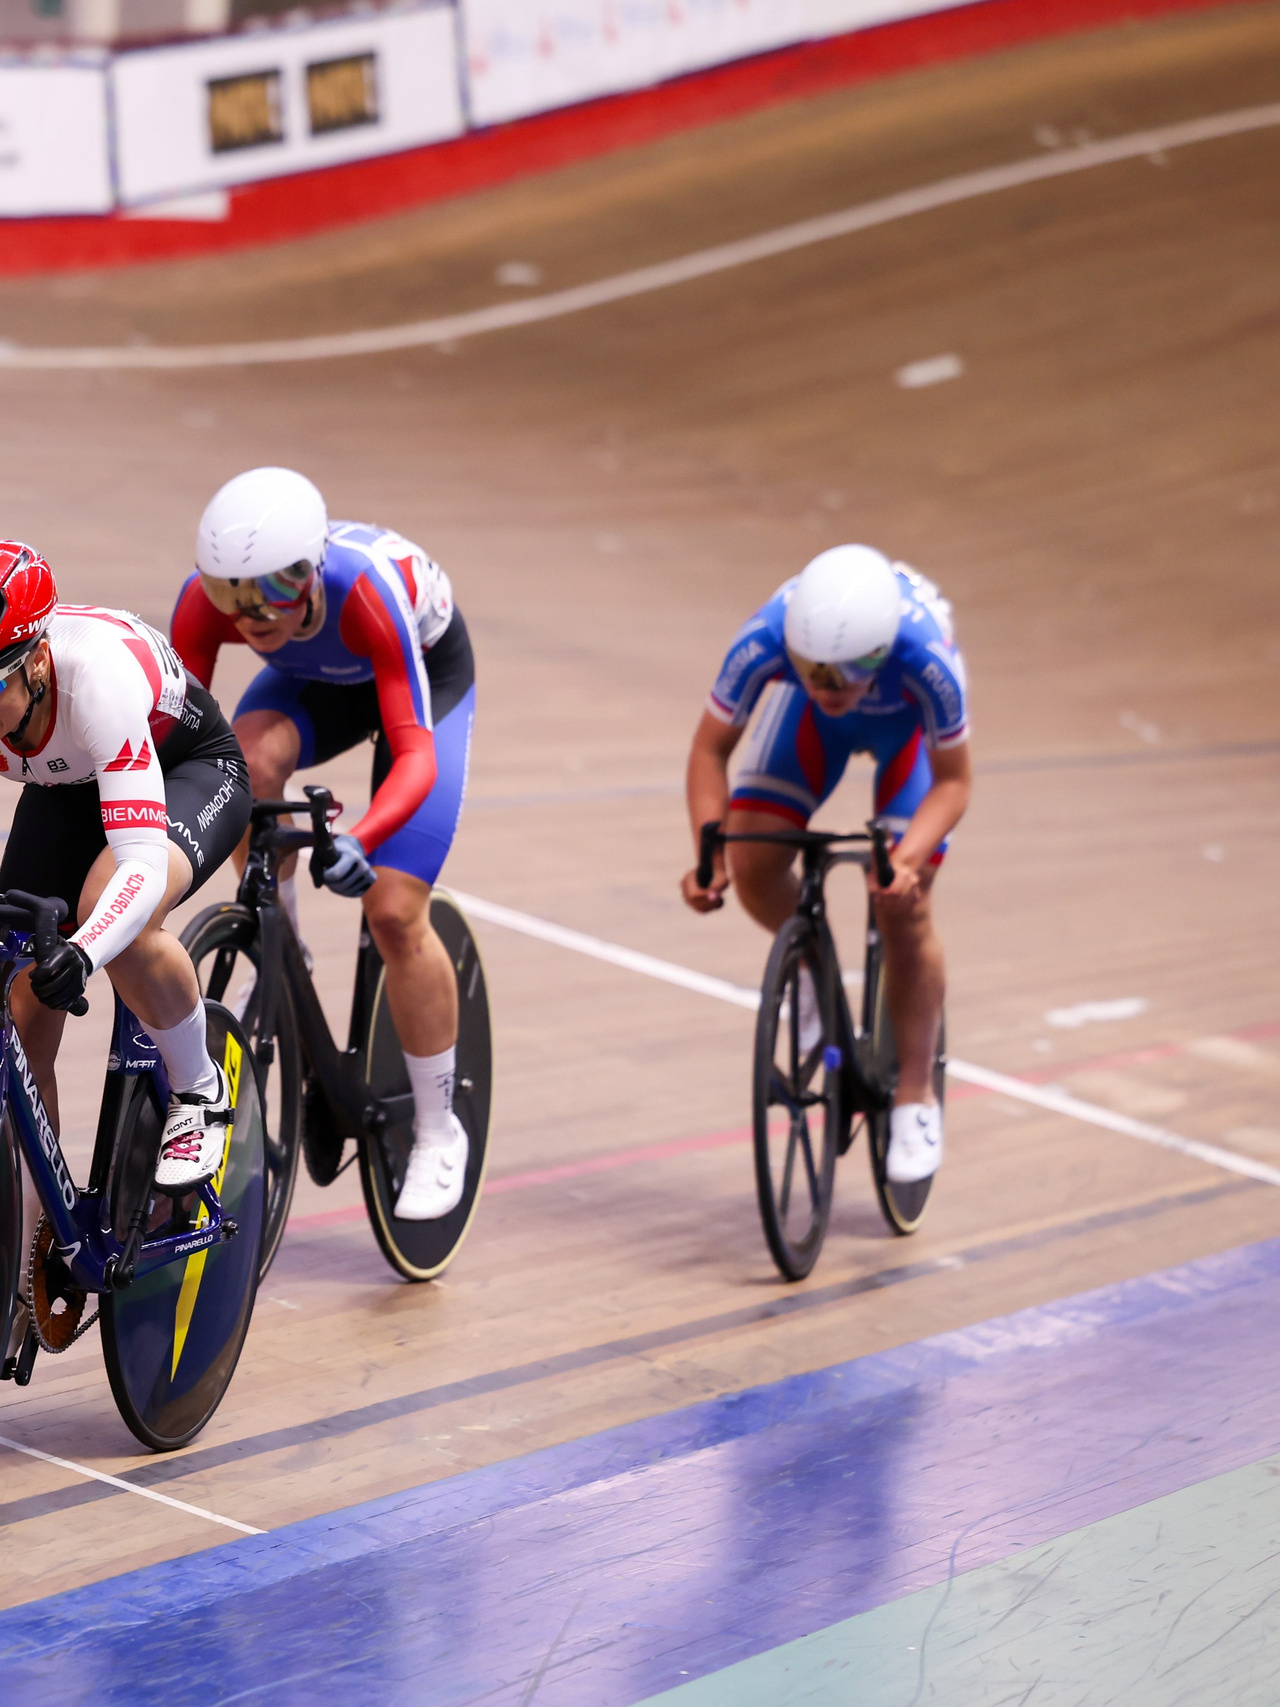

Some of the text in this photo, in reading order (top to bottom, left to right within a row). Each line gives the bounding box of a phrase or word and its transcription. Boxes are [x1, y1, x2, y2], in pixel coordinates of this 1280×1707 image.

[46, 757, 68, 771] B3
[166, 813, 205, 868] MME
[76, 873, 145, 951] УЛЬСКАЯ ОБЛАСТЬ
[9, 1025, 76, 1211] PINARELLO
[167, 1117, 194, 1136] BONT
[174, 1234, 213, 1254] PINARELLO
